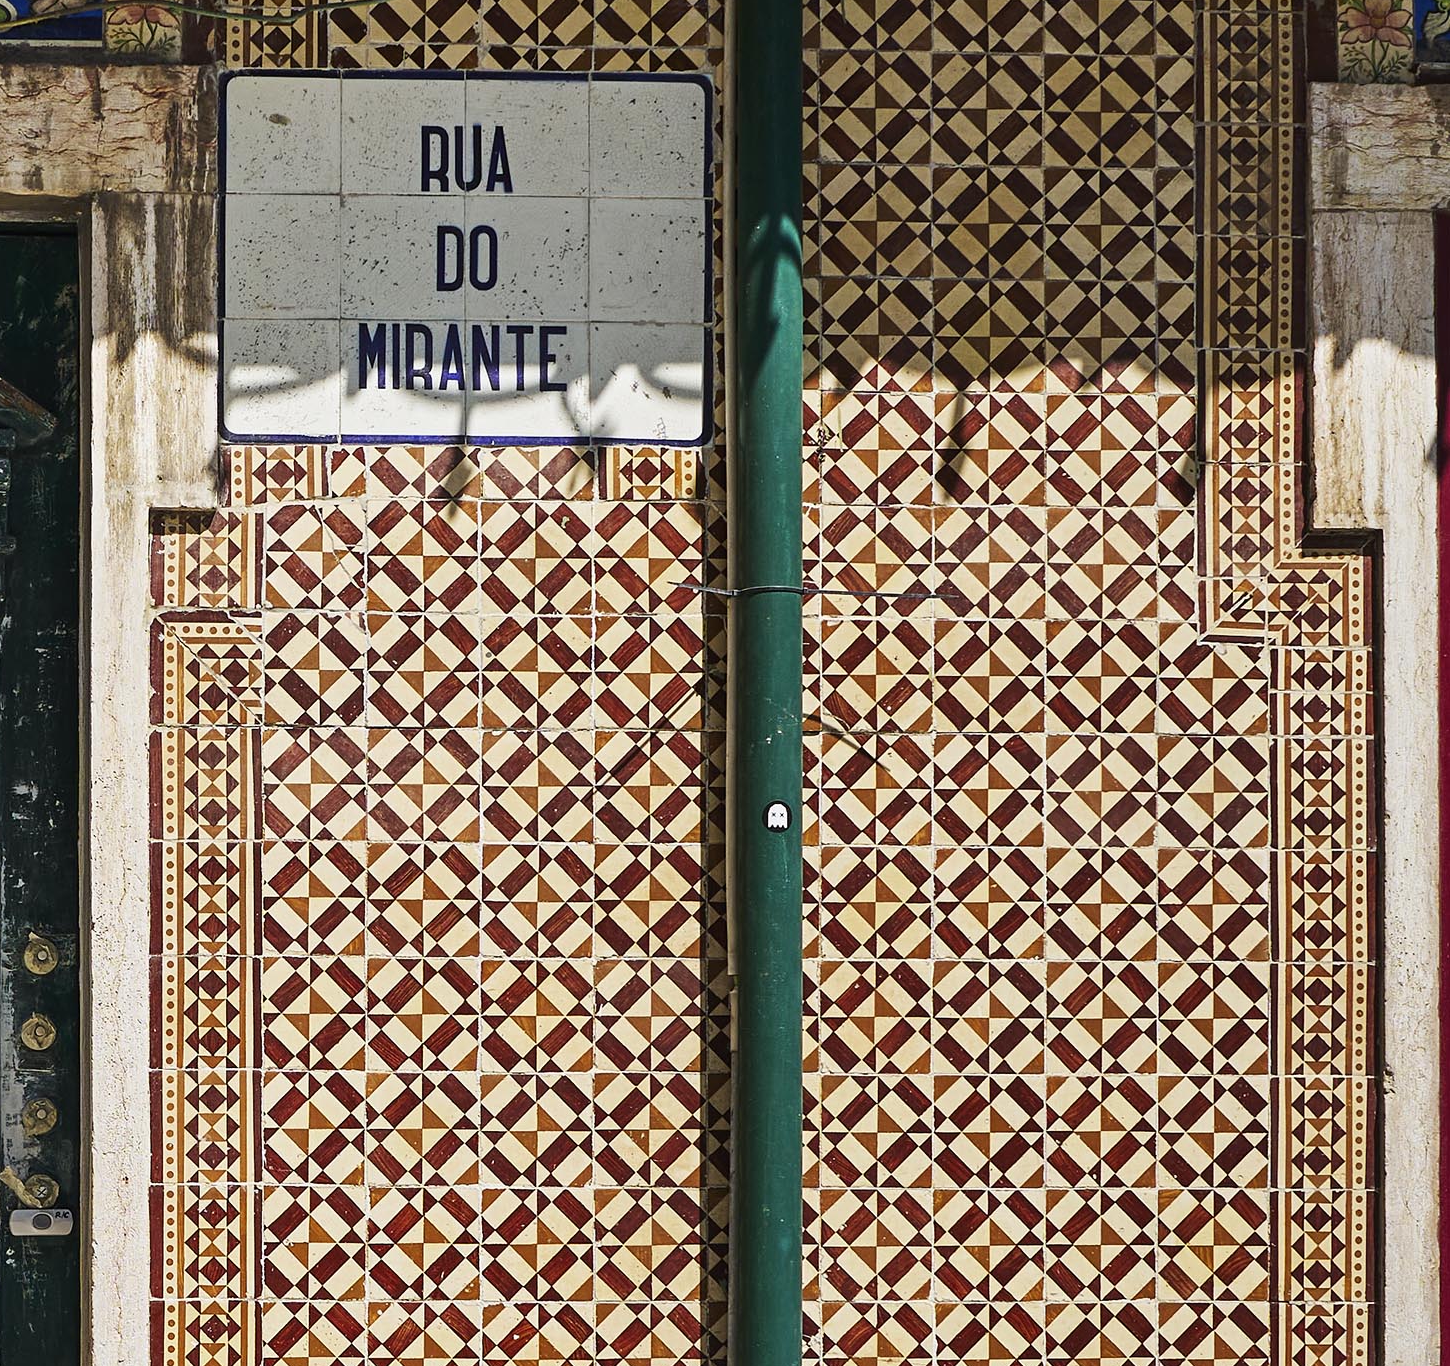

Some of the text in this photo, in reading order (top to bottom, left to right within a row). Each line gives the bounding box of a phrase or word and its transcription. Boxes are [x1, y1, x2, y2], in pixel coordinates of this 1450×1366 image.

[421, 125, 513, 193] RUA
[436, 225, 498, 292] DO
[358, 322, 568, 392] MIRANTE
